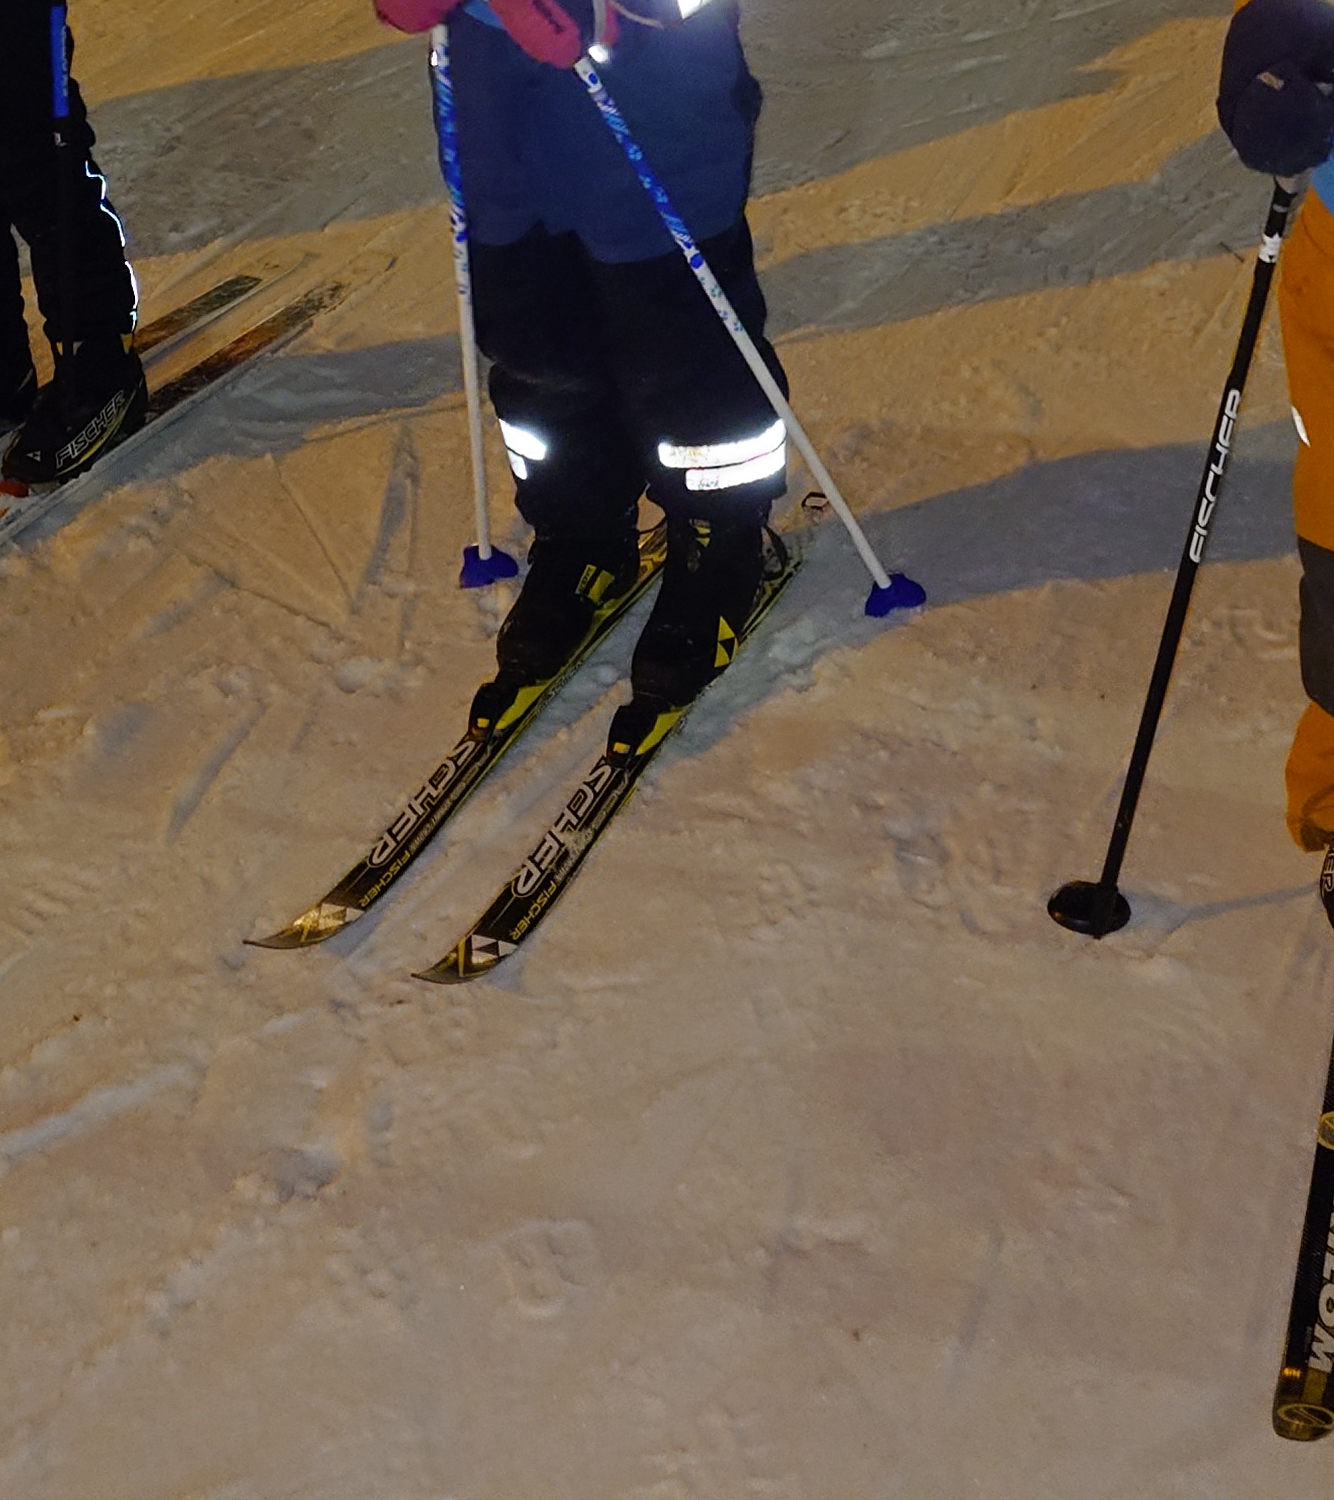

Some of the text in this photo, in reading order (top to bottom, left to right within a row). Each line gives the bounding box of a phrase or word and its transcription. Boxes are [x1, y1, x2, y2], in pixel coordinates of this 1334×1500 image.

[55, 389, 126, 470] FISCHER
[369, 740, 480, 867] SCHER
[515, 755, 613, 896] SCHER
[359, 849, 411, 908] FISCHER
[508, 879, 558, 942] FISCHER
